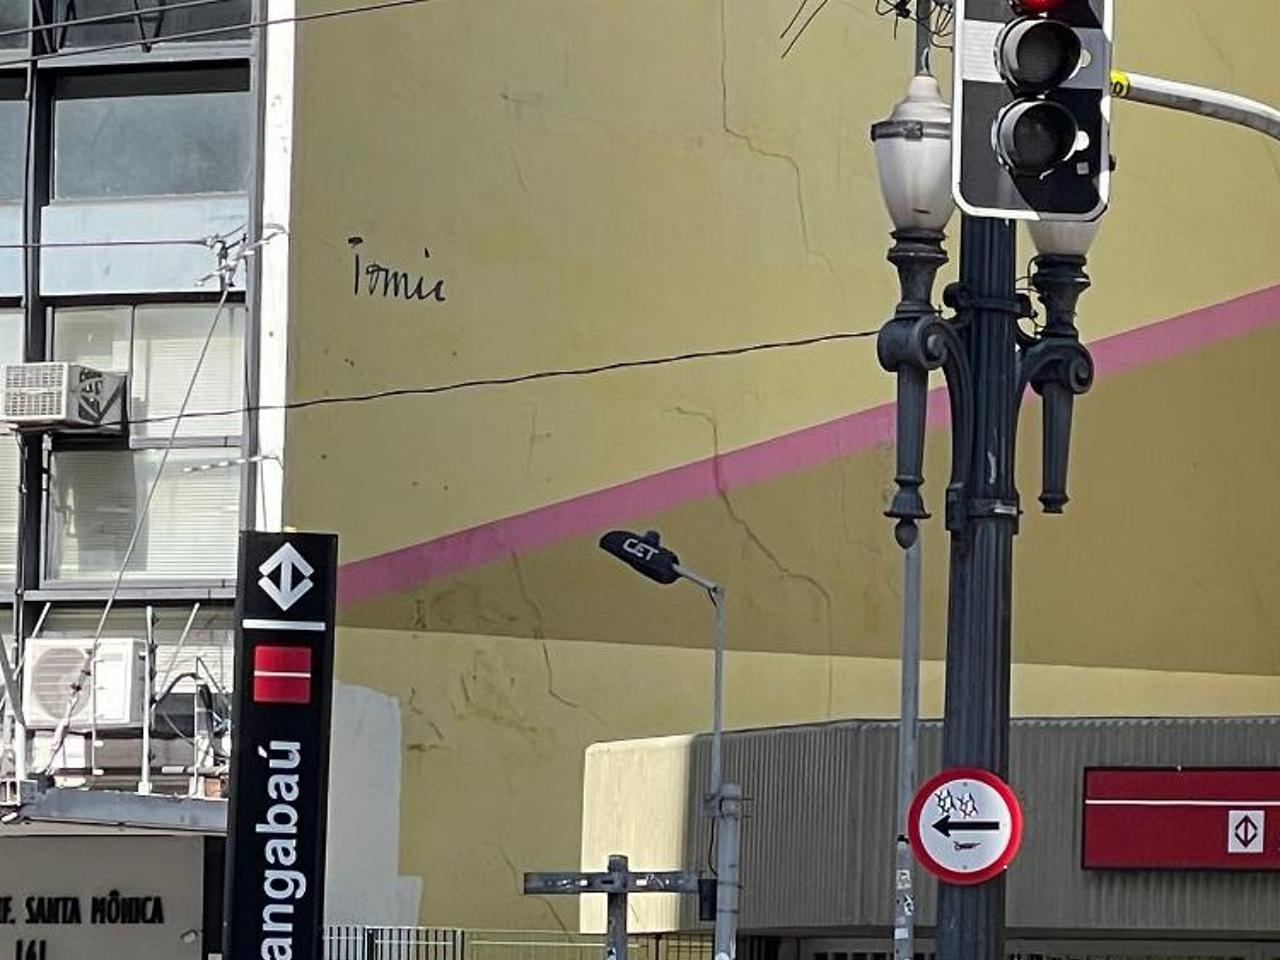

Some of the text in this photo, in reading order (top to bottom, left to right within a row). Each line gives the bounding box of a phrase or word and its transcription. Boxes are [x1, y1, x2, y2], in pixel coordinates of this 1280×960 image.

[623, 538, 659, 560] CET
[25, 897, 82, 924] SANTA
[91, 889, 164, 924] MÔNICA
